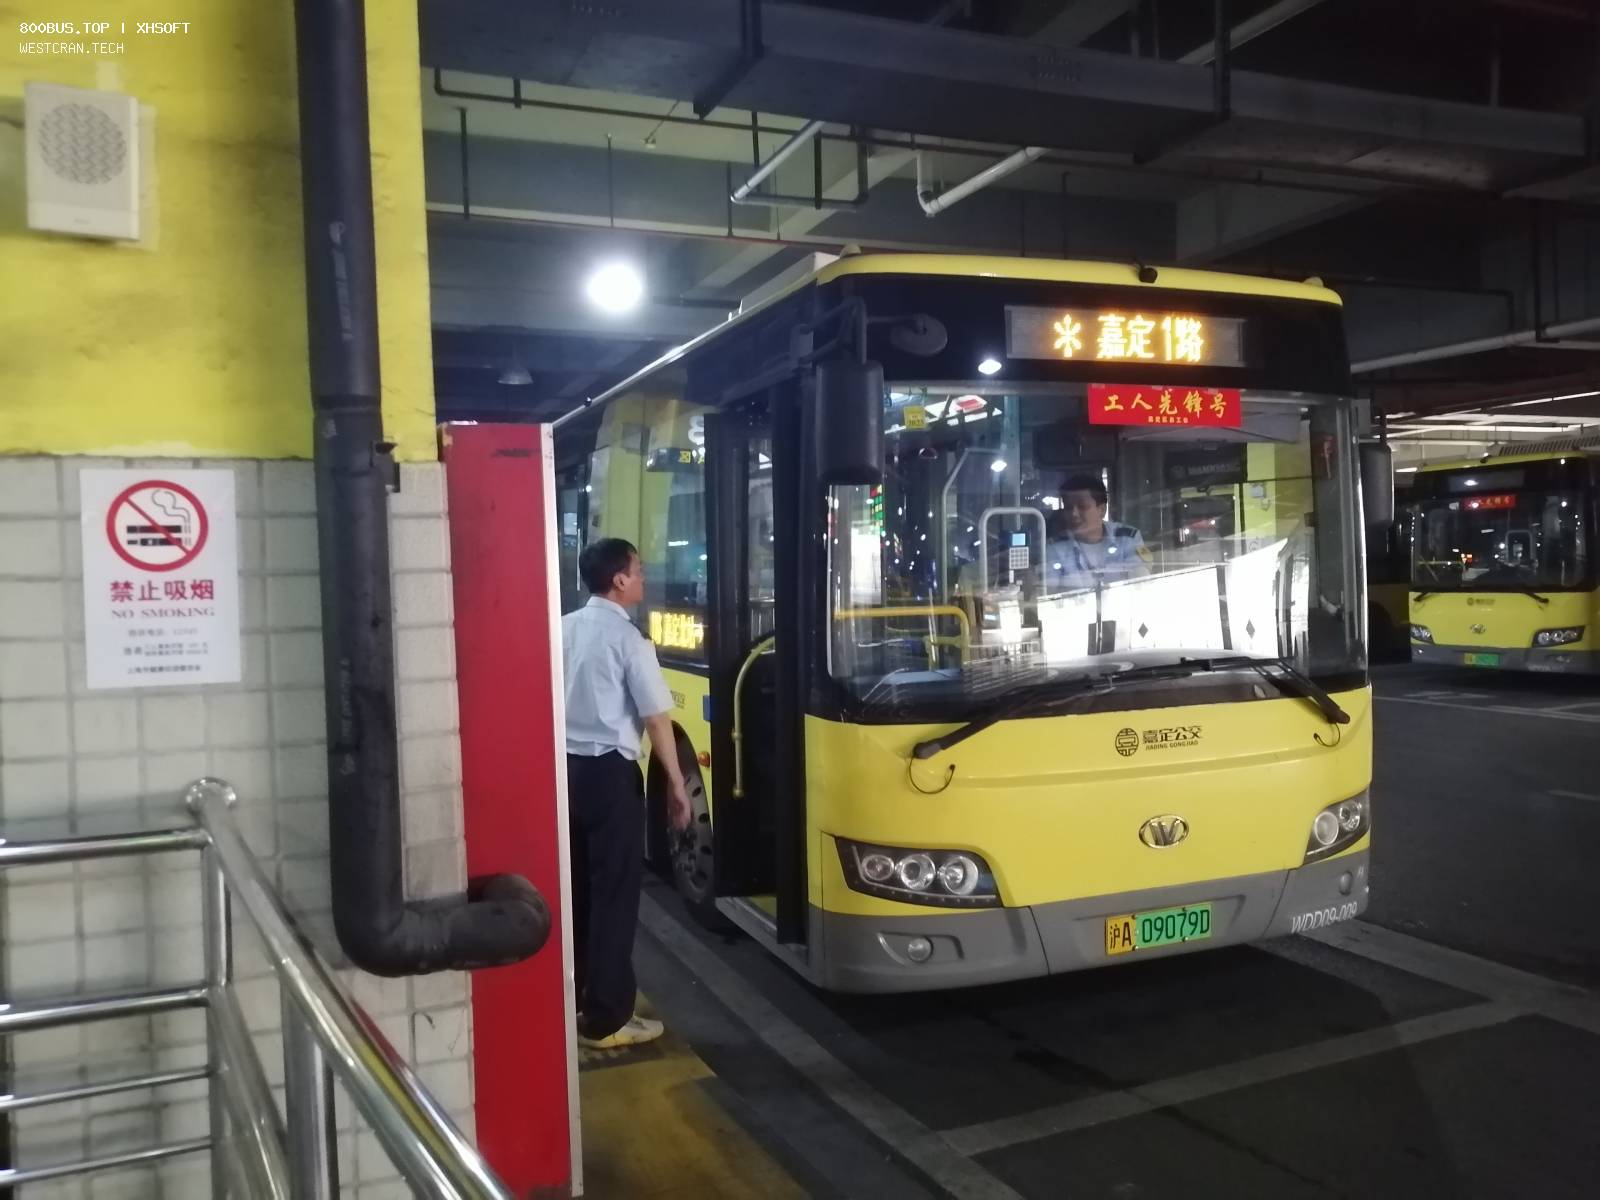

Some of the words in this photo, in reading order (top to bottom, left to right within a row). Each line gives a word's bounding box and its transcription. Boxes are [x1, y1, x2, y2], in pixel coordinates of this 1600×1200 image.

[1103, 389, 1228, 419] 工人先锋号
[110, 579, 215, 602] 禁止吸烟
[111, 609, 134, 618] NO
[141, 606, 215, 618] SMOKING
[1142, 725, 1203, 744] 嘉定公交
